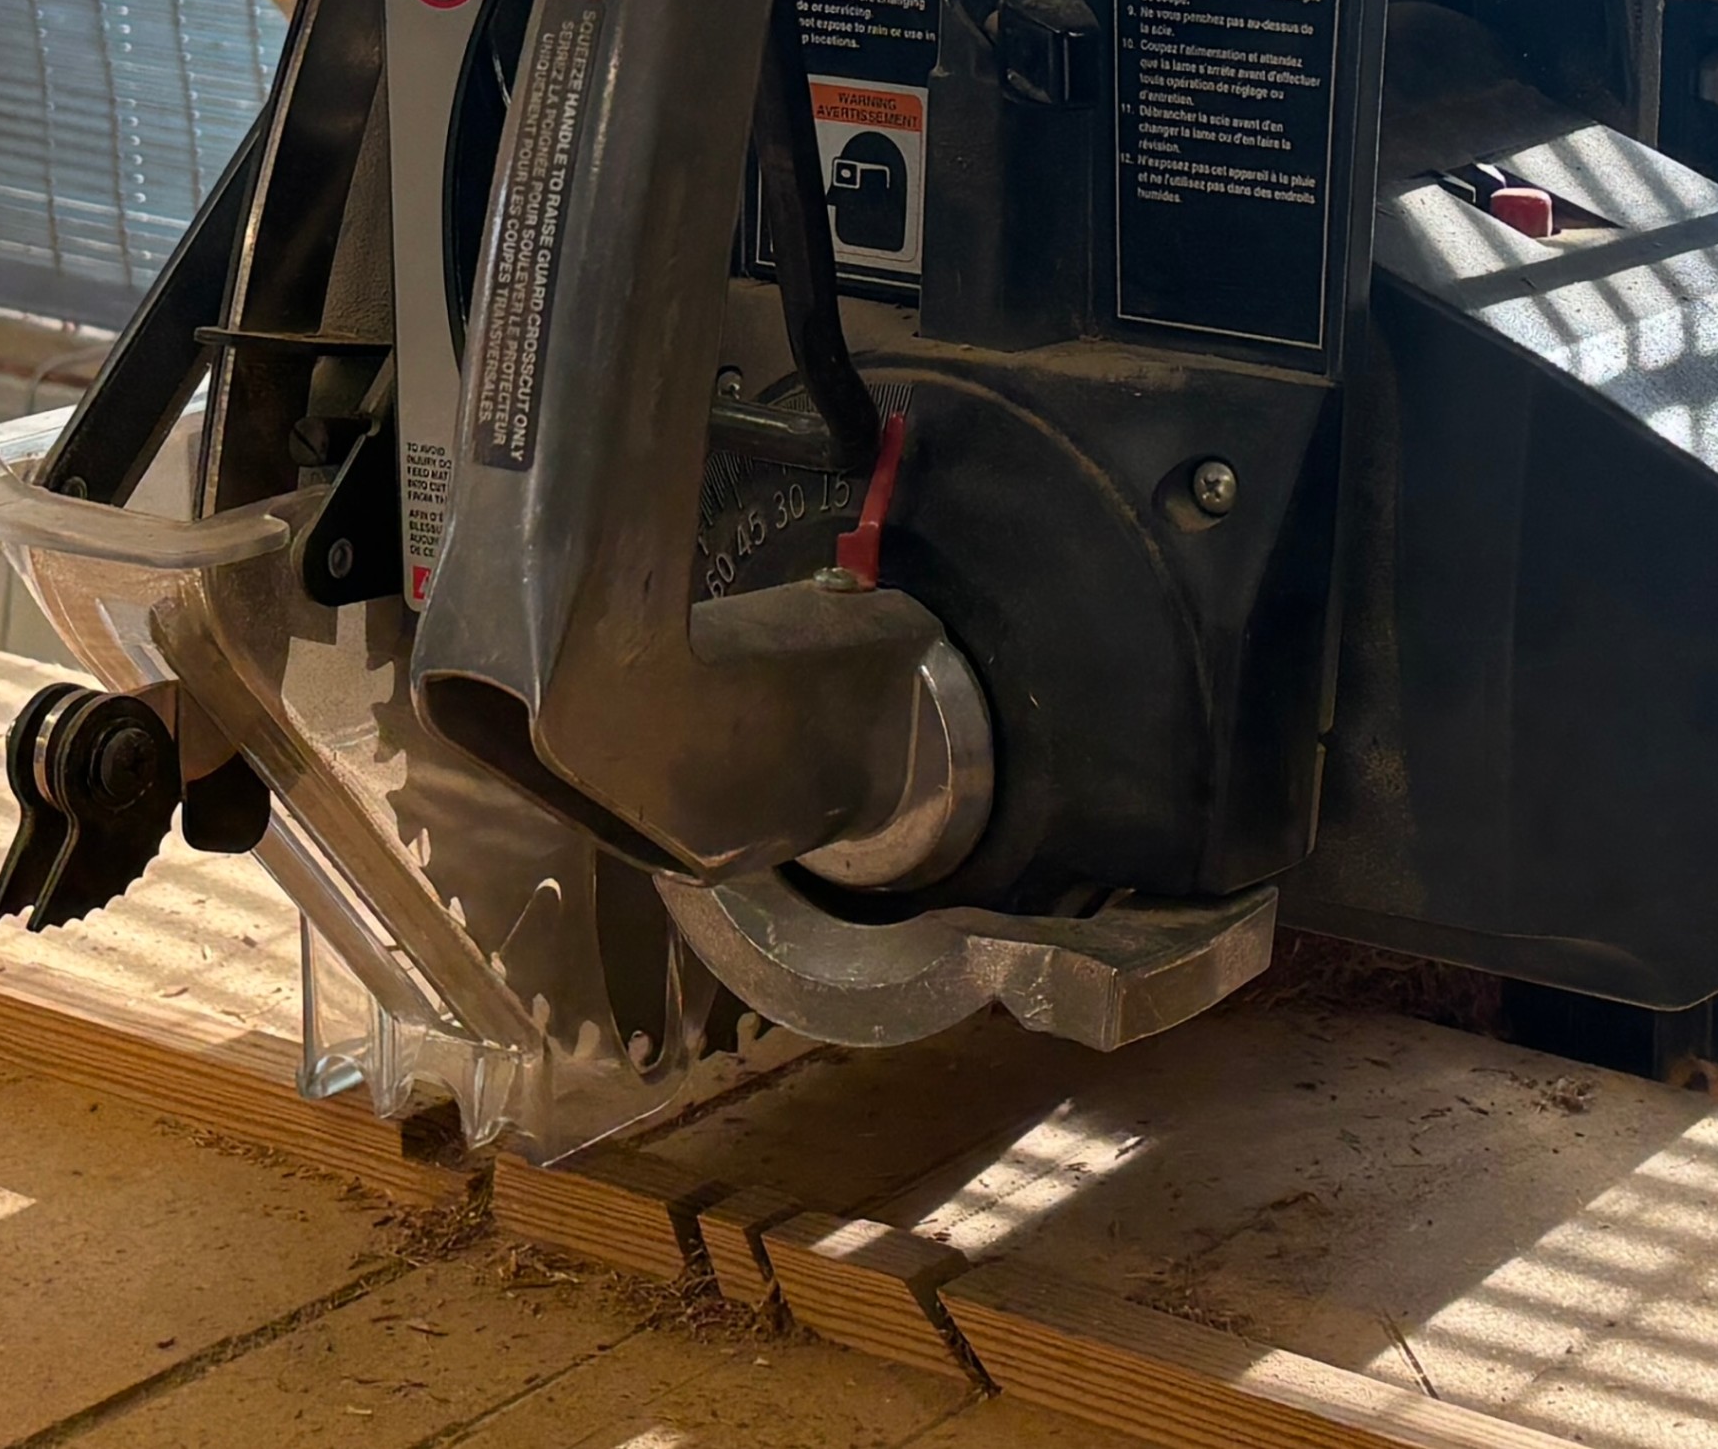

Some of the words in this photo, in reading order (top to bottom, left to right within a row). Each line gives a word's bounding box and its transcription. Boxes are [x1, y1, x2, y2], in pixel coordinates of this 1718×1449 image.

[552, 20, 574, 81] SERREZ
[567, 10, 596, 90] SQUEEZE
[816, 19, 852, 32] expose
[867, 24, 887, 35] rain
[524, 33, 555, 135] UNIQUEMENT
[546, 84, 560, 104] LA
[838, 93, 897, 110] WARNING
[554, 93, 580, 165] HANDLE
[817, 105, 920, 127] AVERTISSEMENT
[515, 140, 534, 182] POUR
[550, 169, 566, 191] TO
[1290, 174, 1316, 187] pluie
[509, 185, 525, 217] LES
[524, 181, 544, 226] POUR
[539, 194, 561, 248] RAISE
[498, 220, 520, 283] COUPES
[510, 227, 536, 313] SOULEVER
[530, 250, 551, 311] GUARD
[506, 316, 521, 337] LE
[517, 314, 541, 412] CROSSCUT
[493, 341, 518, 446] PROTECTEUR
[510, 413, 528, 462] ONLY
[706, 553, 734, 598] 60
[737, 511, 766, 556] 45
[773, 483, 805, 529] 30
[820, 470, 851, 511] 15
